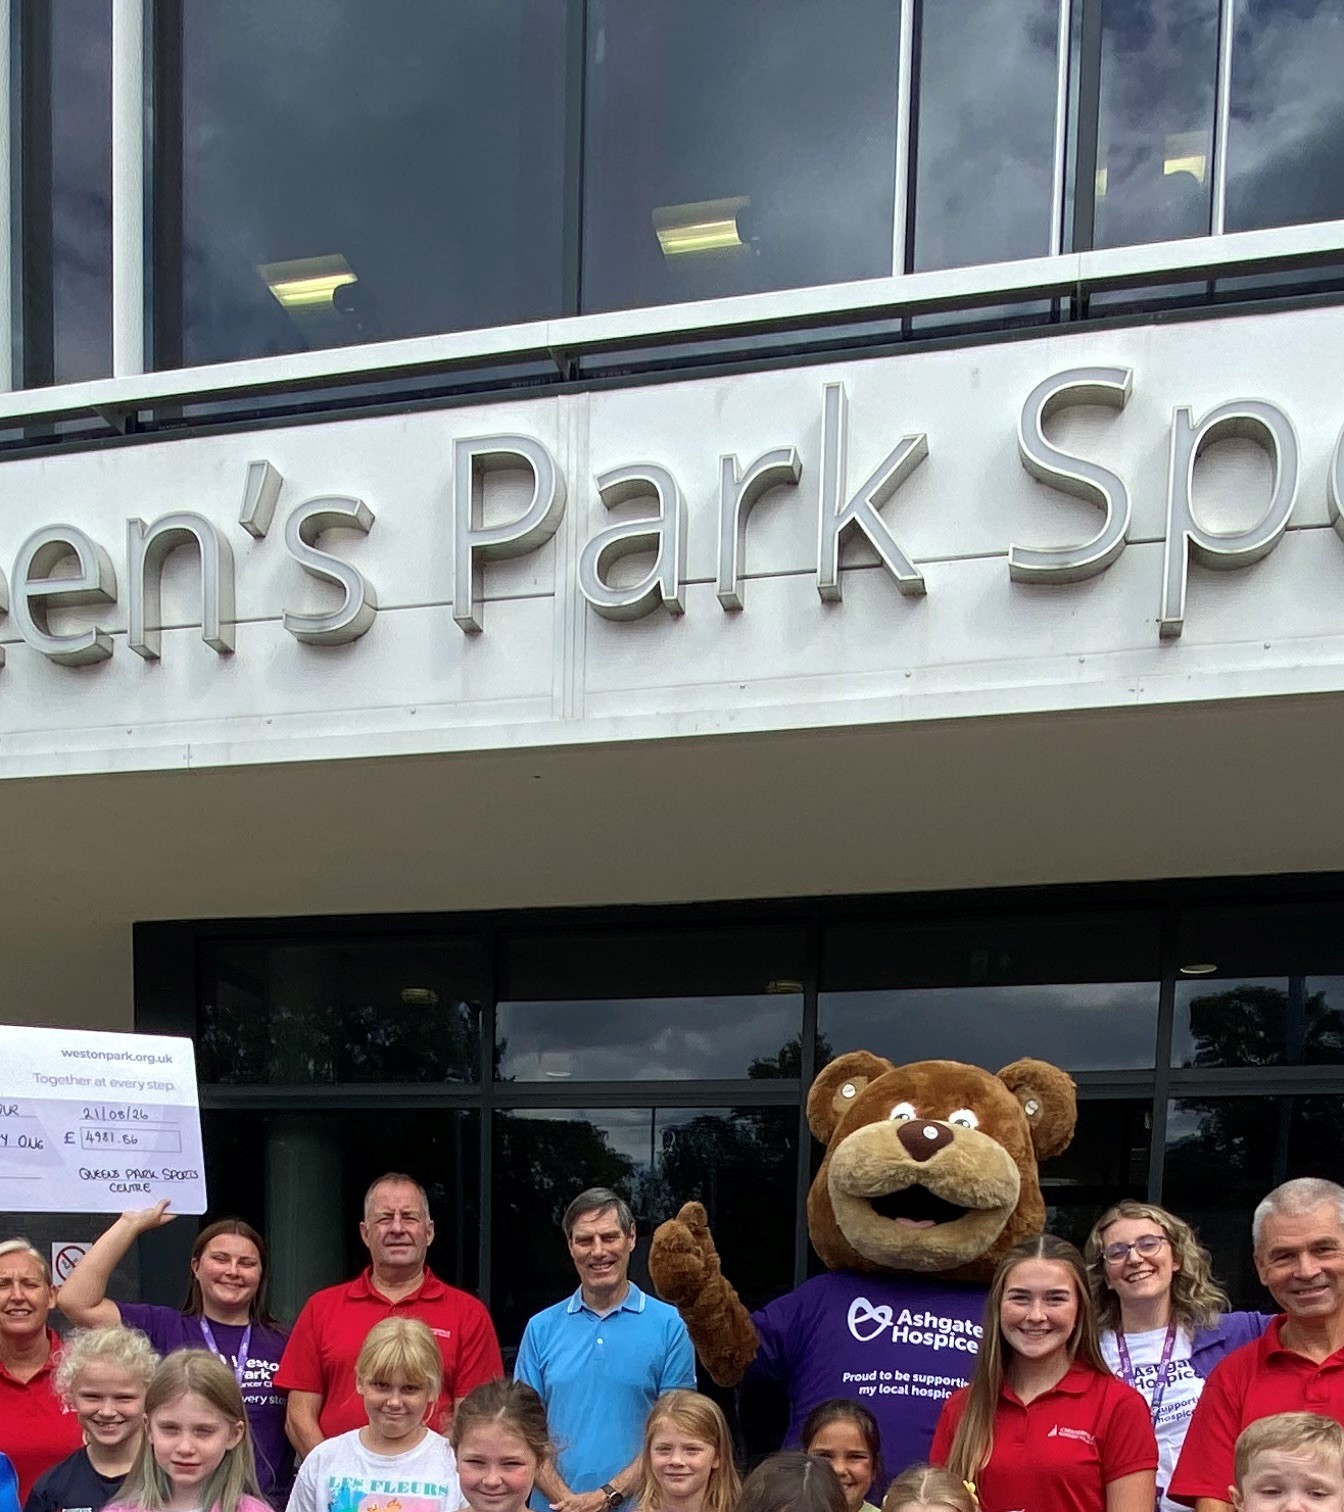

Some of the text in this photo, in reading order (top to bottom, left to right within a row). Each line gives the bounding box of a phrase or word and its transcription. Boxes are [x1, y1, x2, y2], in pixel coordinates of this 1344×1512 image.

[451, 380, 929, 635] Park
[61, 1049, 173, 1064] westonpark.org.uk
[33, 1072, 177, 1092] Together at every step.
[64, 1131, 76, 1144] £
[125, 1168, 159, 1180] PARK
[161, 1168, 199, 1180] SPORTS
[109, 1182, 151, 1193] CENTRE
[897, 1309, 983, 1338] Ashgate
[892, 1326, 979, 1354] Hospice
[244, 1368, 271, 1380] ark
[843, 1371, 877, 1382] Proud
[879, 1371, 892, 1380] to
[895, 1370, 910, 1381] be
[859, 1384, 952, 1400] my local hospic
[242, 1395, 268, 1405] very
[370, 1479, 449, 1497] FLEURS
